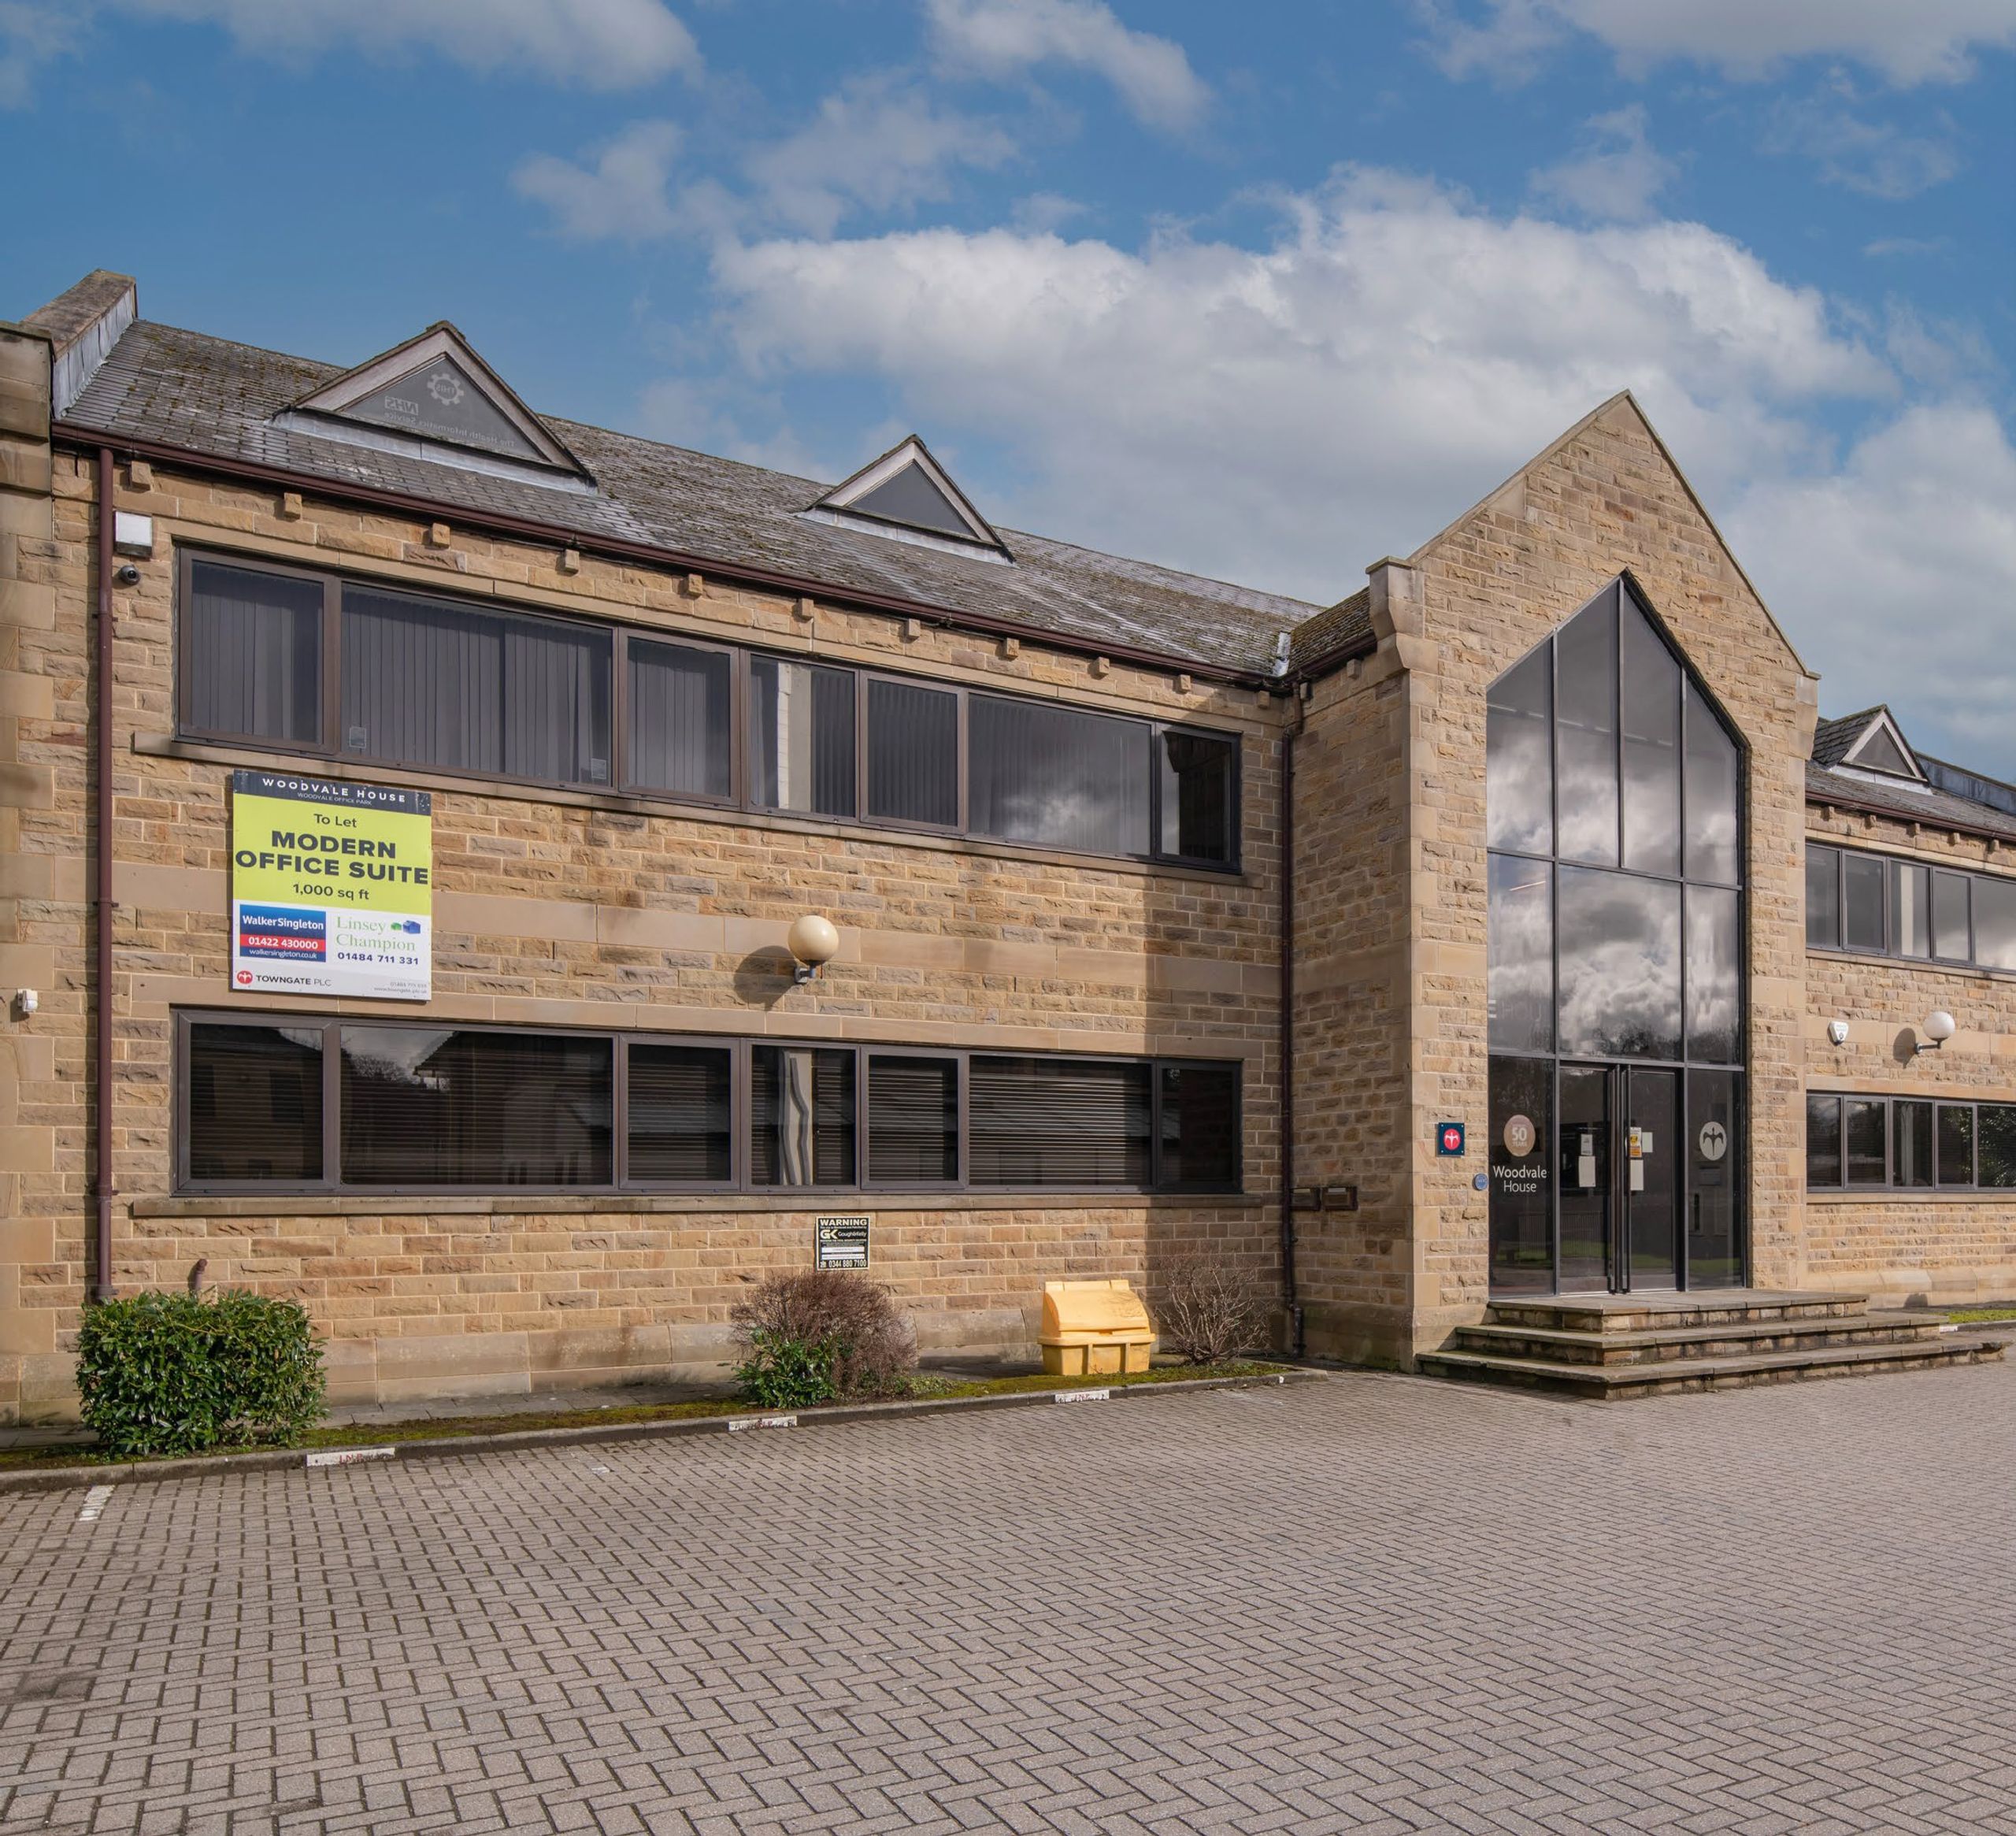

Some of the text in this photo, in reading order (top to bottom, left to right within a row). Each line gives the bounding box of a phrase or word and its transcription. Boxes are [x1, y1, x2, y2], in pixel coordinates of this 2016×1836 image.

[262, 777, 406, 803] WOODVALE HOUSE
[297, 792, 334, 801] WOODVALE
[313, 813, 357, 828] To Let
[271, 830, 396, 859] MODERN
[235, 850, 428, 885] OFFICE SUITE
[293, 883, 370, 901] 1,000 sq ft
[336, 916, 386, 935] Linsey
[248, 937, 318, 949] 01422 430000
[336, 933, 416, 952] Champion
[249, 948, 317, 959] walkersingleton.co.uk
[337, 951, 419, 965] 01484 711 331
[256, 975, 332, 987] TOWNGATE PLC
[1511, 1126, 1528, 1141] 50
[1492, 1164, 1547, 1179] Woodvale
[1503, 1180, 1537, 1192] House
[820, 1229, 838, 1240] GK
[828, 1259, 842, 1268] 0344
[854, 1259, 867, 1267] 7100
